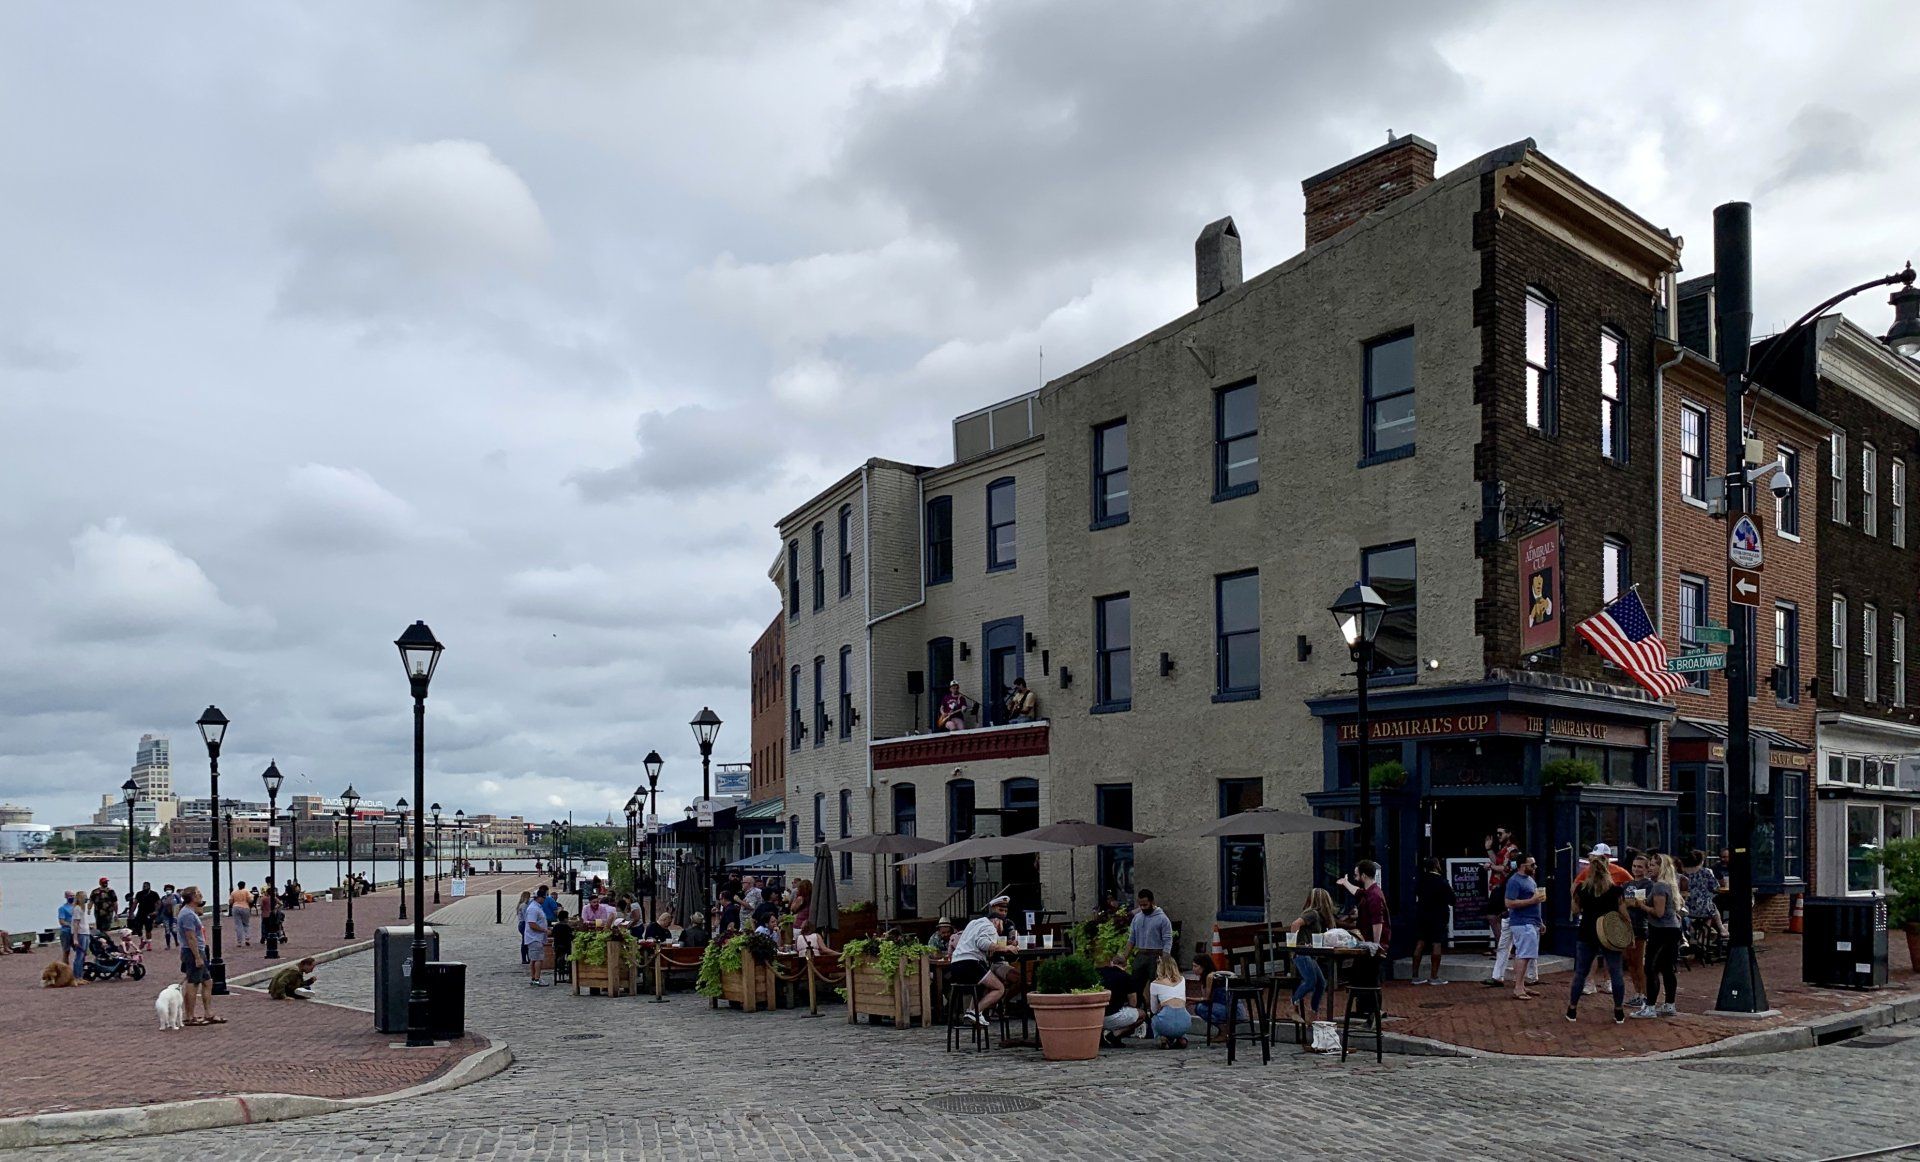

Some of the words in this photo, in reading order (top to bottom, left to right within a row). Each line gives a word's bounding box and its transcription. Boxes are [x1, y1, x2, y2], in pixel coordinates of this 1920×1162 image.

[1676, 655, 1723, 670] BROADWAY
[1341, 723, 1361, 739] TH
[1372, 717, 1452, 738] ADMIRAL'S
[1458, 714, 1489, 731] CUP
[1527, 716, 1544, 732] THE
[1592, 723, 1608, 739] CUP
